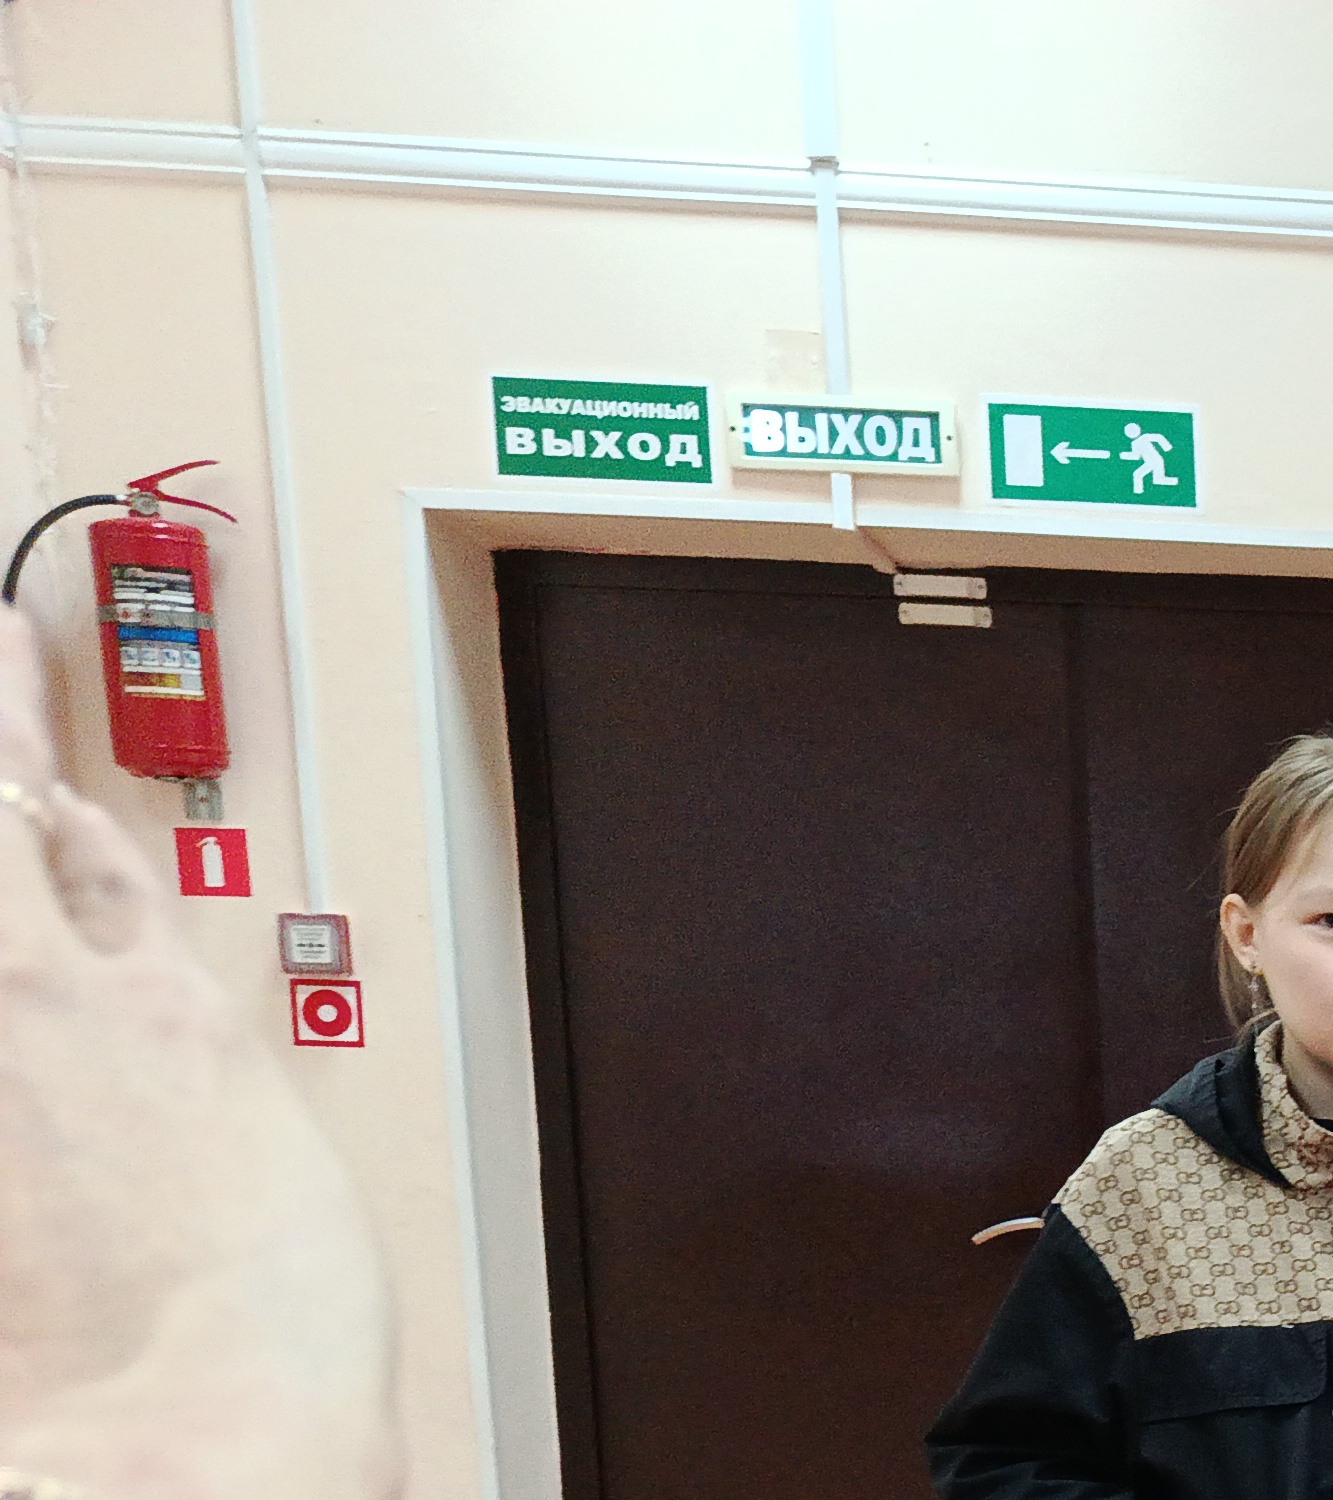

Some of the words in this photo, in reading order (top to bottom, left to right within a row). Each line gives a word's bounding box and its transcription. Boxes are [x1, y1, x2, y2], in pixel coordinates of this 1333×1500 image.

[500, 395, 701, 421] ЭВАКУАЦИОННЫЙ
[504, 426, 704, 468] ВЫХОД
[749, 408, 936, 463] ВЫХОД
